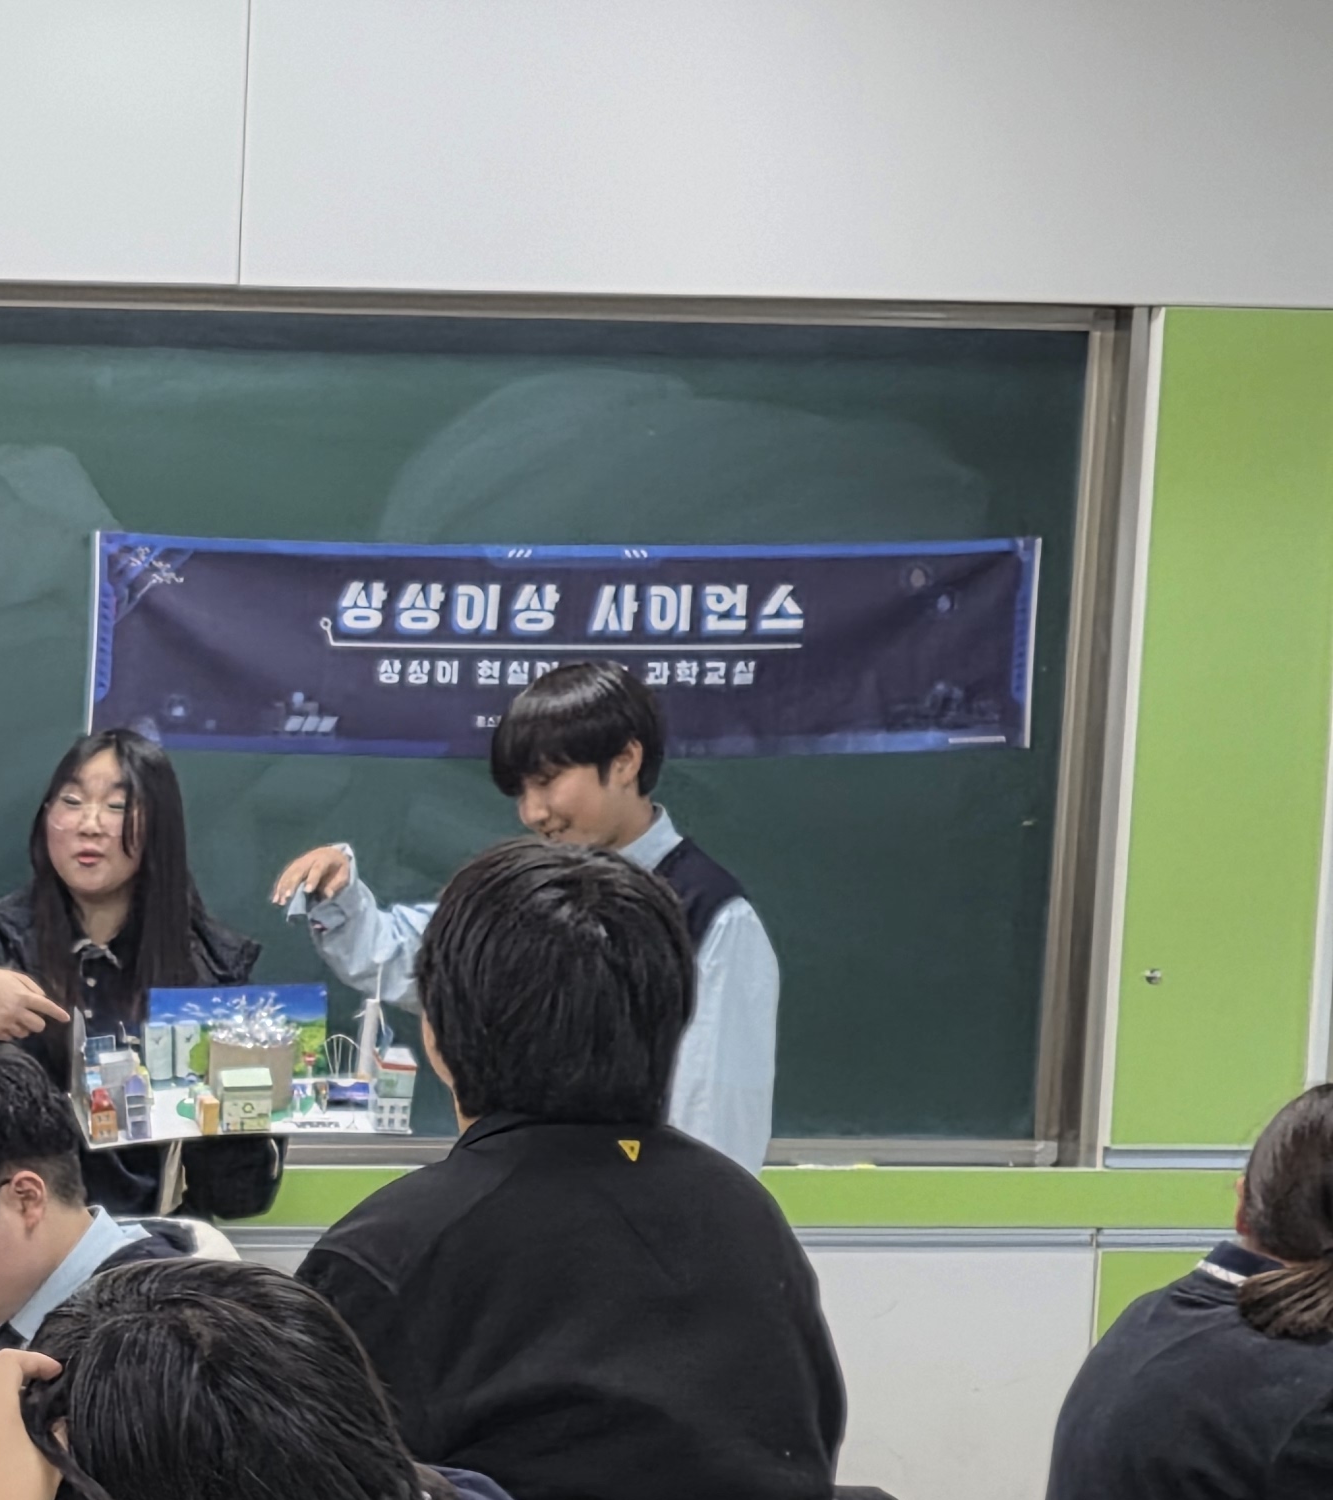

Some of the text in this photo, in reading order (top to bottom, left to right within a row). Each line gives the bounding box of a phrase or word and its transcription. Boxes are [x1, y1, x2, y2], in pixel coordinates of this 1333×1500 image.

[340, 580, 805, 632] 상상이상 사이언스
[378, 658, 460, 685] 상상이
[645, 660, 757, 686] 과학교실
